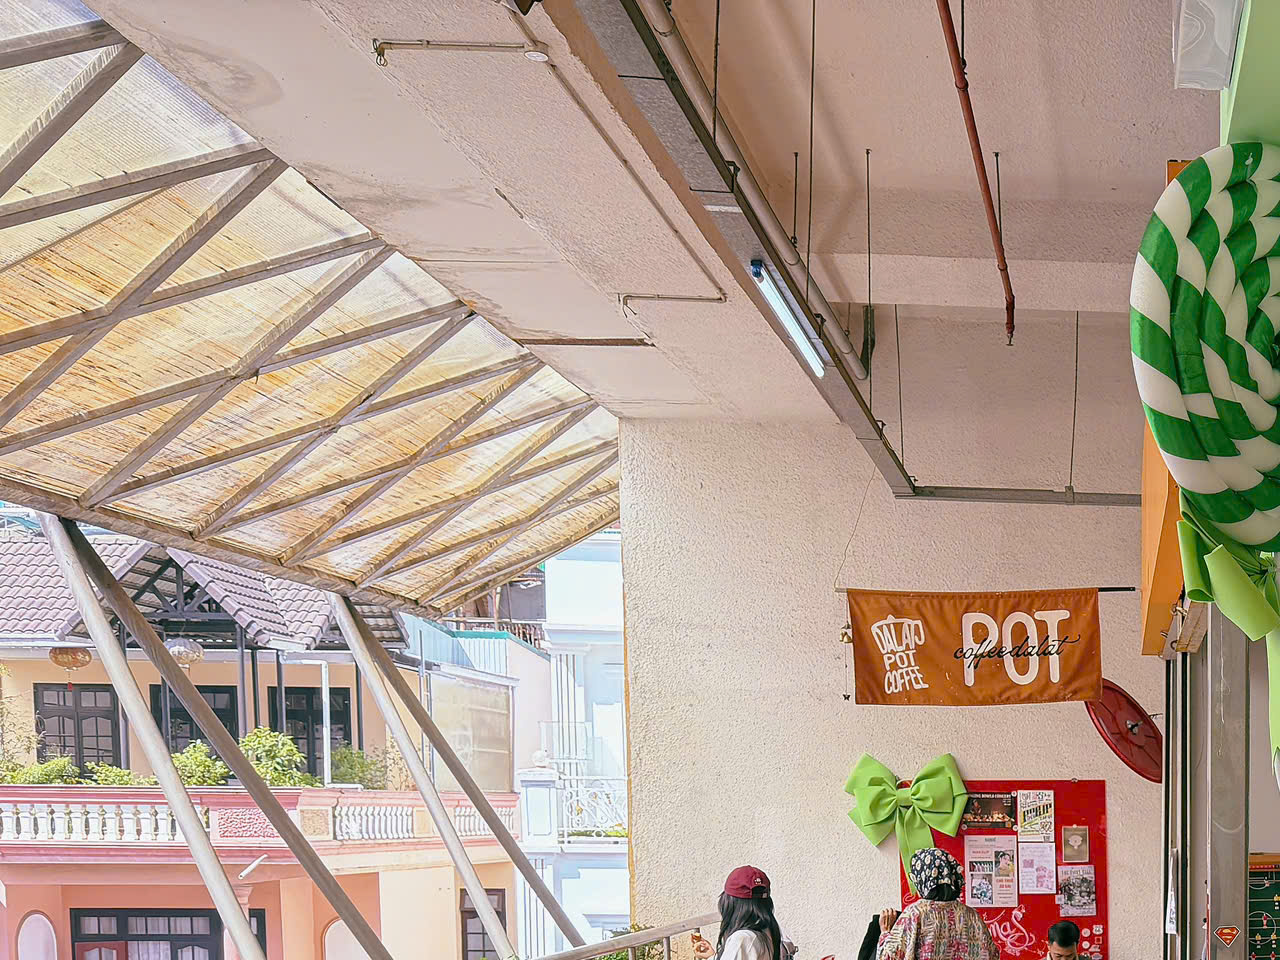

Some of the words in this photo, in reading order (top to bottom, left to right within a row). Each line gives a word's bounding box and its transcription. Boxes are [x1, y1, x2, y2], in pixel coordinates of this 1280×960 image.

[883, 651, 918, 671] POT
[961, 609, 1070, 687] POT
[883, 665, 929, 695] COFFEE
